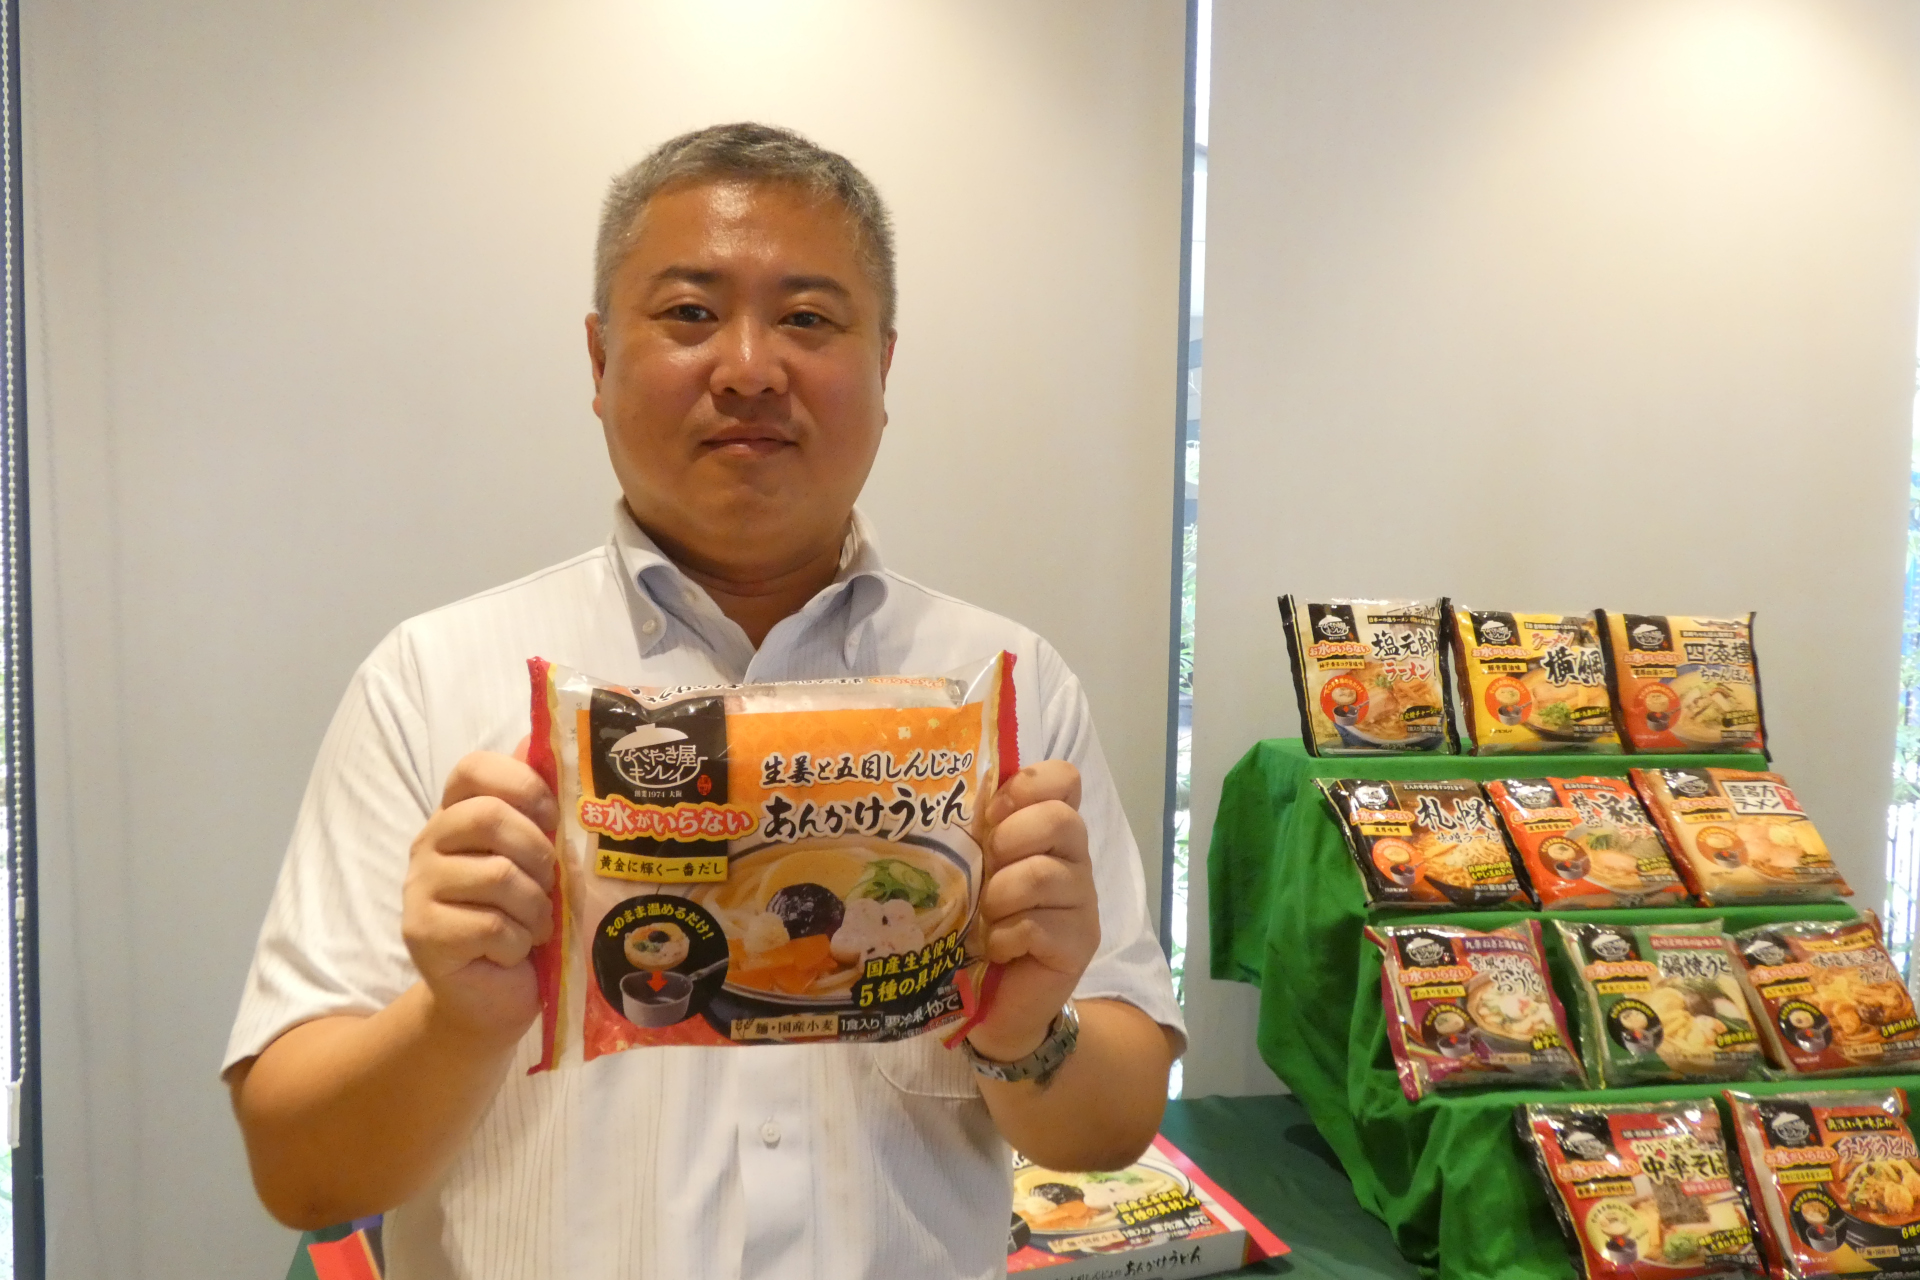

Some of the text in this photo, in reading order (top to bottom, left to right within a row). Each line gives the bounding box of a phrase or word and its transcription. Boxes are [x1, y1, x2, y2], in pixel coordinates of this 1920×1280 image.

[1309, 644, 1369, 658] お水がいらない
[1371, 629, 1438, 658] 塩元帥
[1472, 646, 1531, 659] お水がいらない
[1532, 632, 1573, 649] ラーメン
[1384, 661, 1432, 681] ラーメン
[1544, 646, 1605, 685] 横綱
[620, 745, 697, 767] なべやき屋
[760, 750, 973, 787] 生姜と五目しんじょの
[669, 789, 683, 798] 大阪
[1733, 798, 1782, 810] ラーメン
[582, 801, 750, 836] お水がいらない
[764, 780, 972, 841] あんかけうどん
[1417, 797, 1496, 831] 札幌
[600, 856, 723, 878] 黄金に輝く一番だし
[606, 902, 714, 941] そのまま温めるだけ!
[867, 932, 957, 979] 国産生姜使用
[860, 946, 964, 1007] 5種の具材入り
[841, 1017, 881, 1032] 1食入り
[926, 993, 960, 1018] ゆで
[1641, 1153, 1728, 1180] 中華そば
